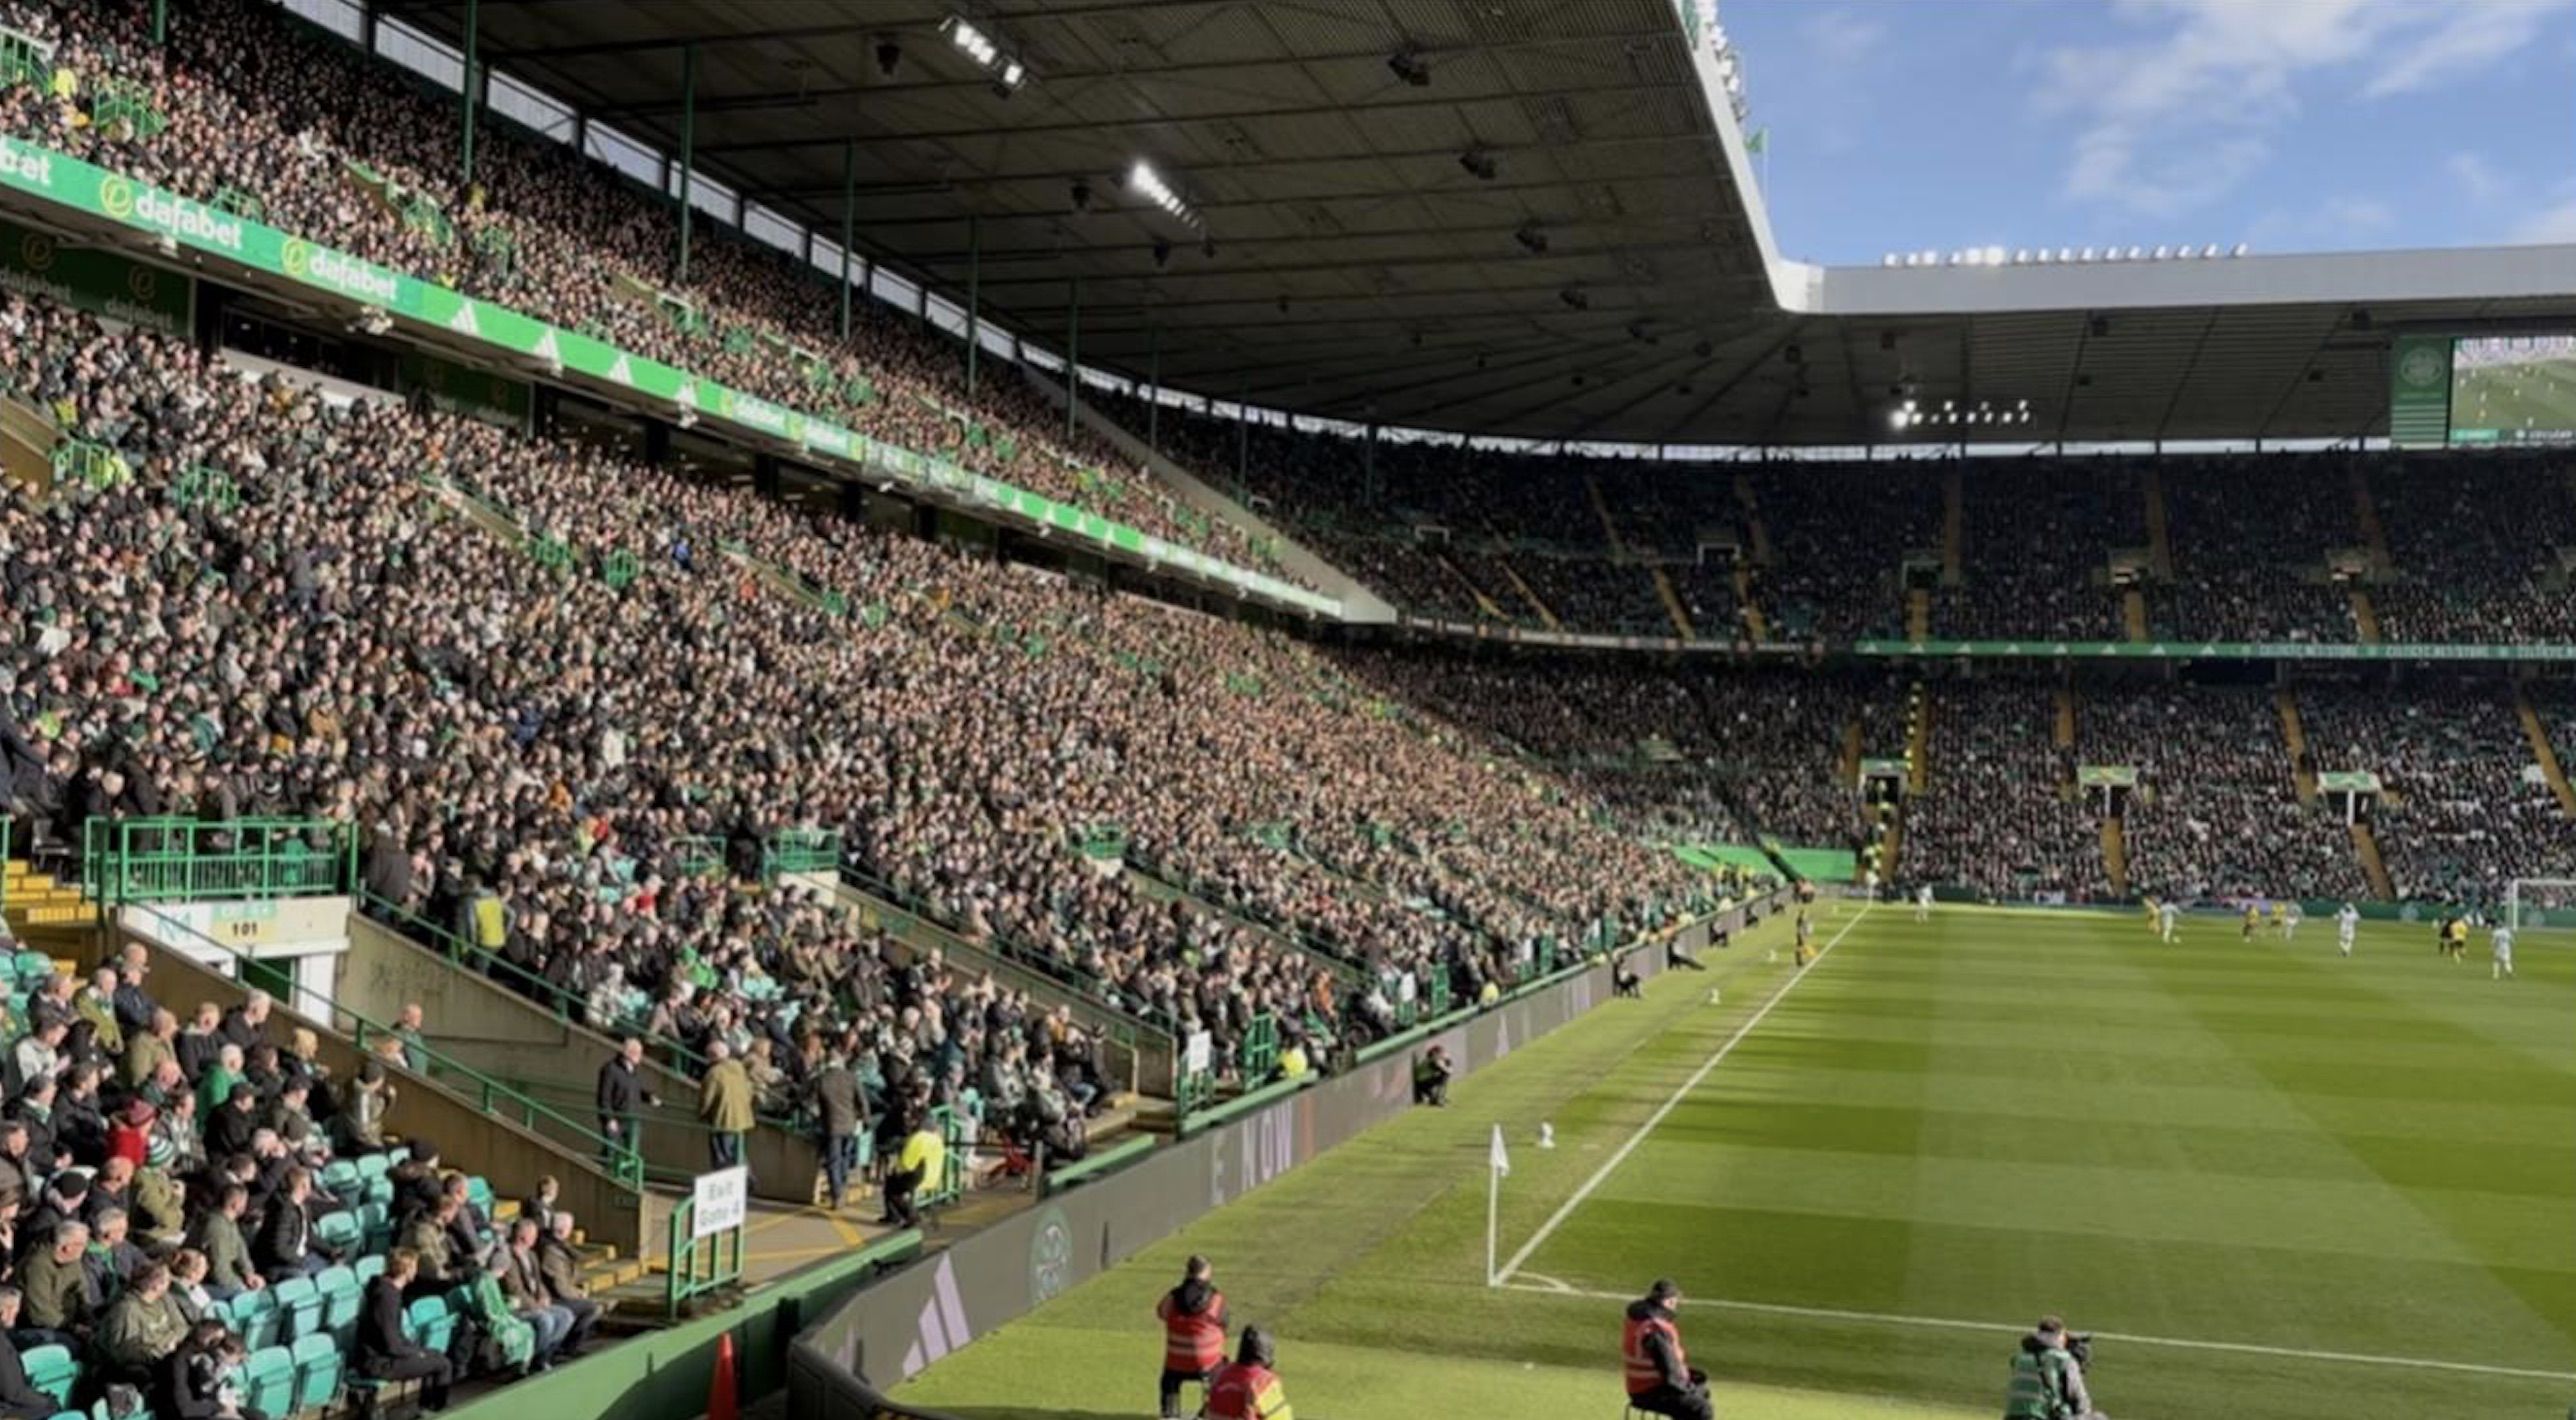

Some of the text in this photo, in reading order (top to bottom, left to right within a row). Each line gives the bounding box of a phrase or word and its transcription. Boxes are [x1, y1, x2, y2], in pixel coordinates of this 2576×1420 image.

[135, 187, 243, 250] dafabet
[310, 248, 398, 301] dafabet
[232, 922, 258, 937] 101
[1241, 1098, 1293, 1193] NOW
[708, 1181, 734, 1201] Exit
